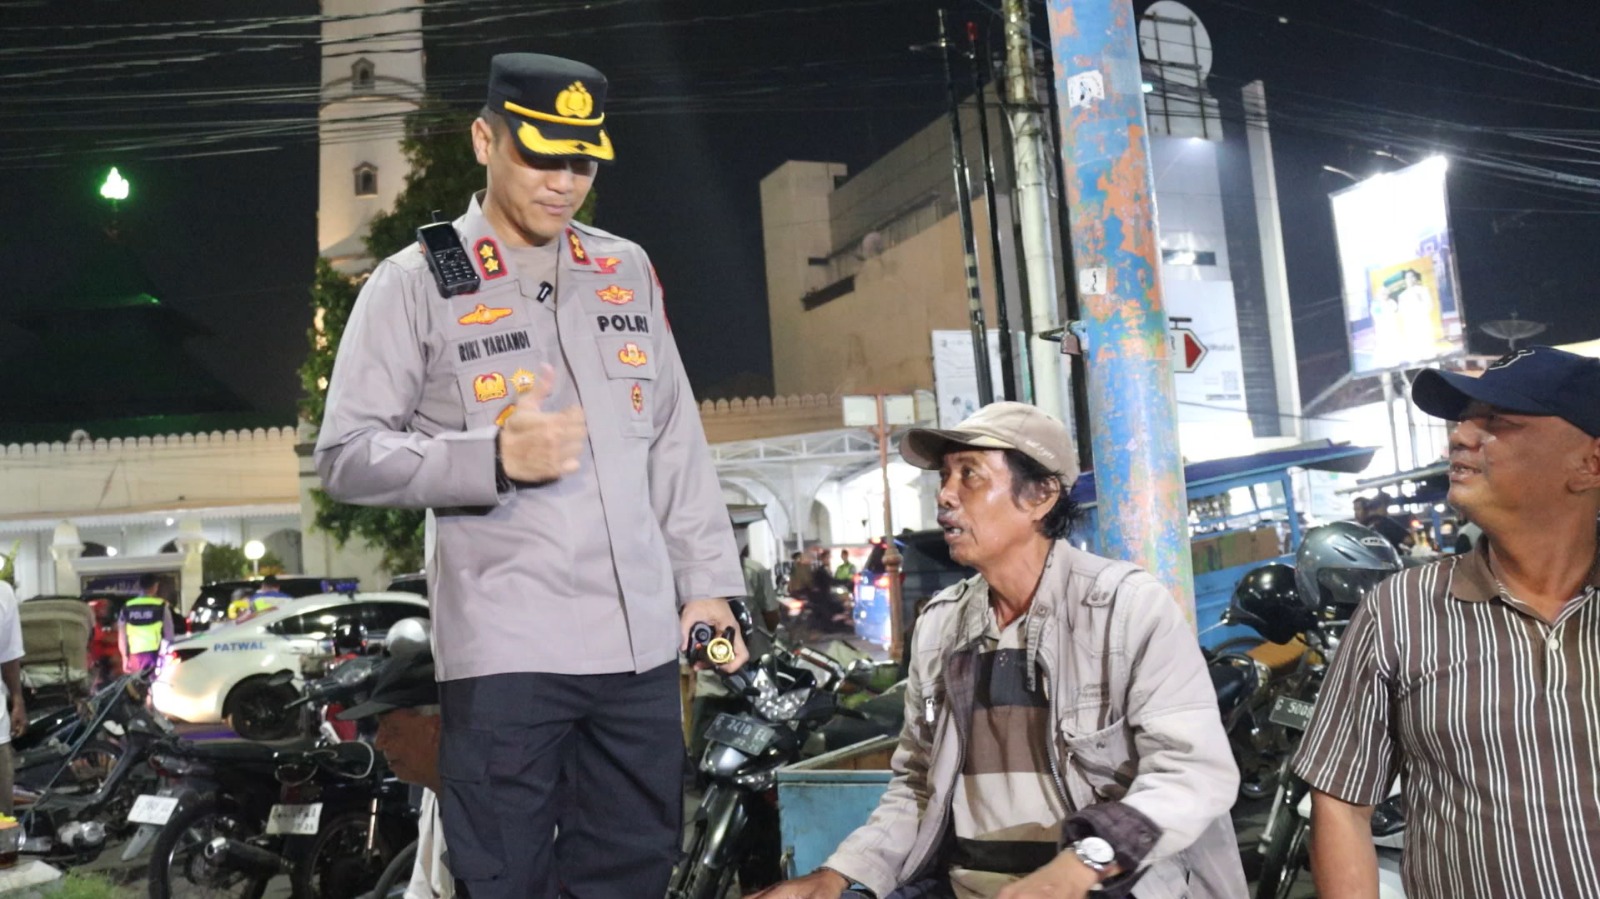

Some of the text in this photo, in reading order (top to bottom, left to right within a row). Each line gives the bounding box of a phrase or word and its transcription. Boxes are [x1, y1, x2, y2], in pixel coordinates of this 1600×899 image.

[597, 315, 649, 334] POLRI
[458, 330, 531, 363] RIKI YARIANDI
[129, 610, 153, 620] POLISI
[213, 641, 266, 652] PATWAL
